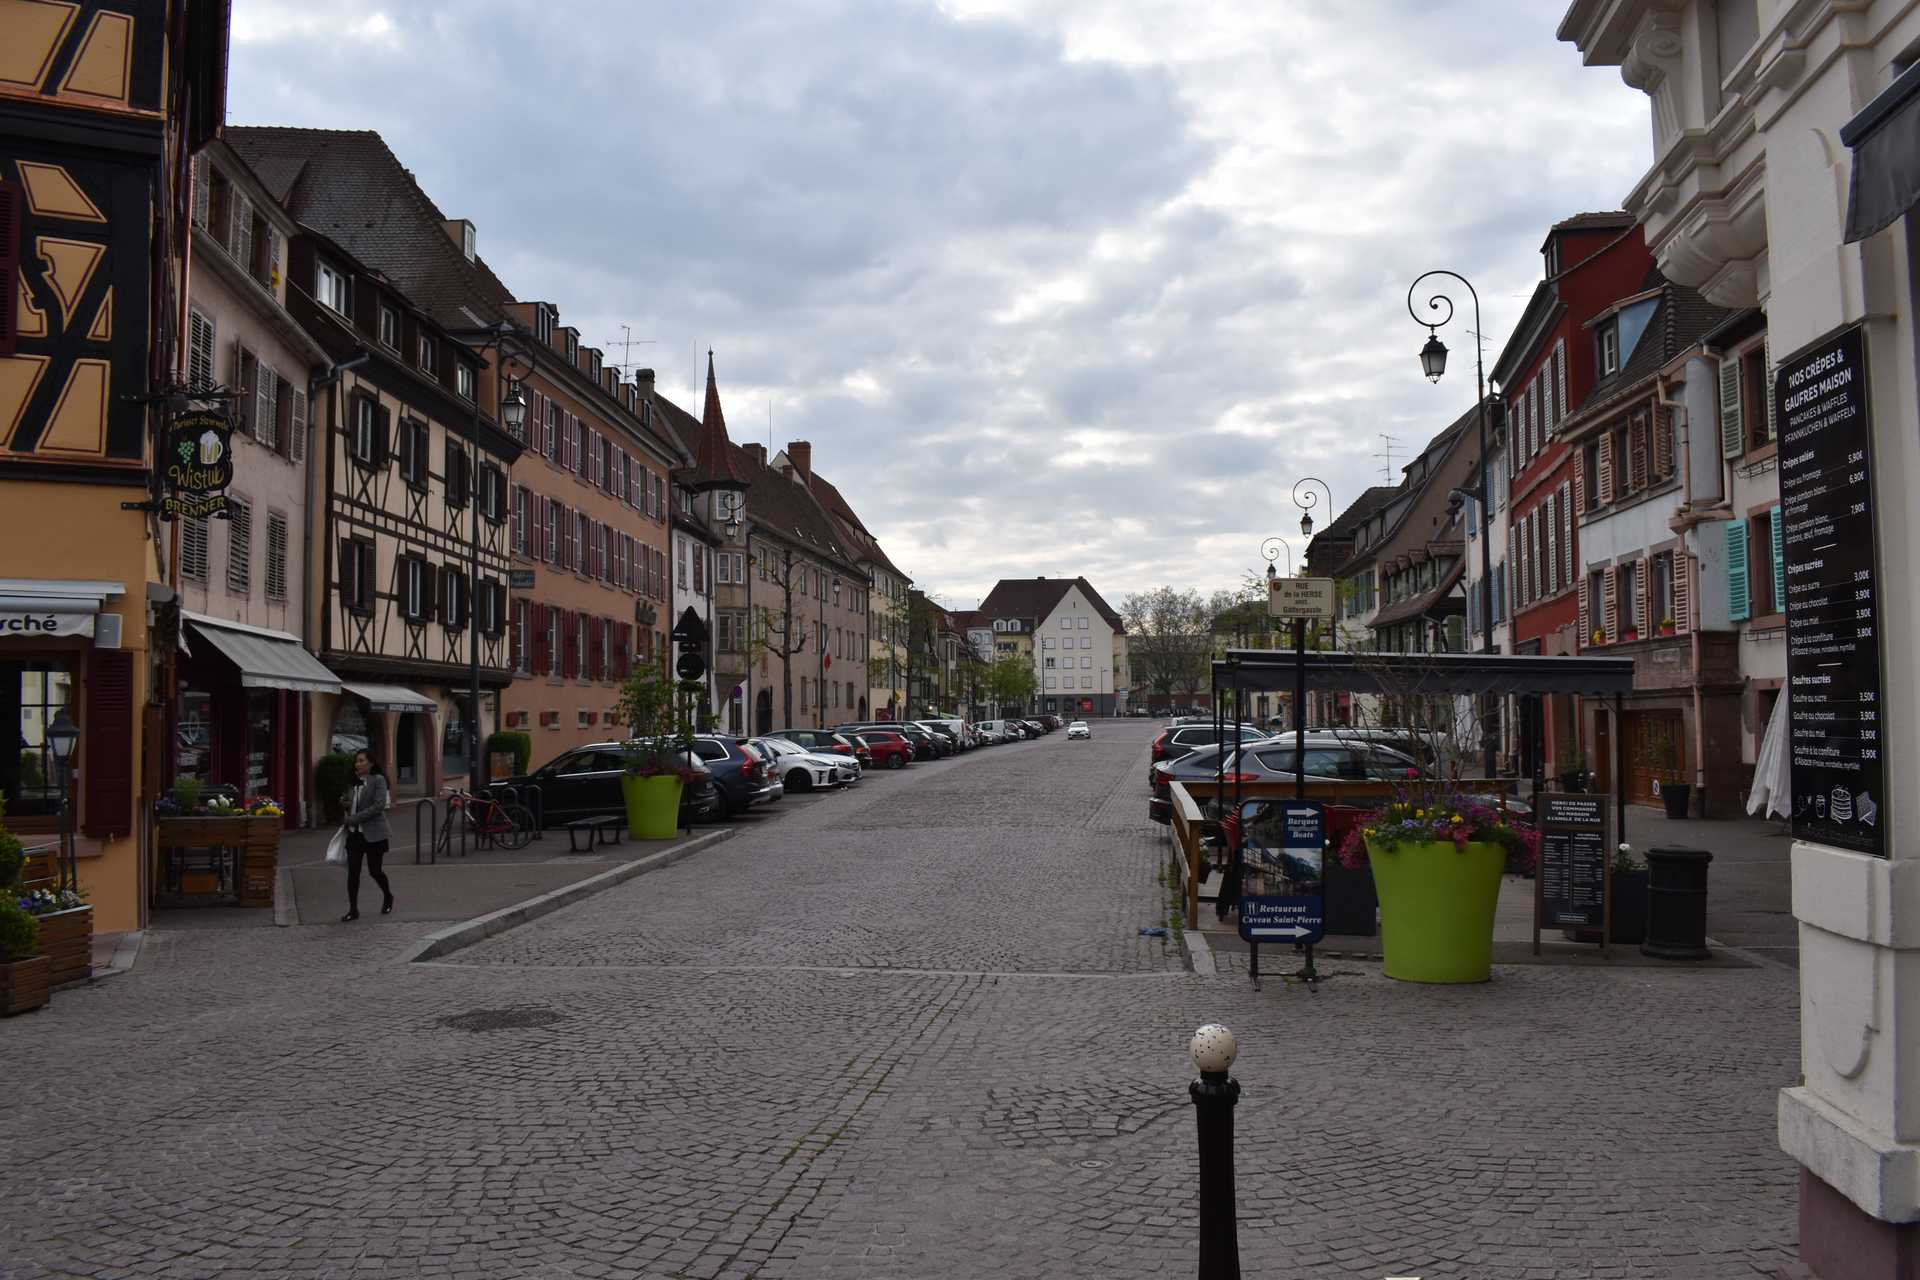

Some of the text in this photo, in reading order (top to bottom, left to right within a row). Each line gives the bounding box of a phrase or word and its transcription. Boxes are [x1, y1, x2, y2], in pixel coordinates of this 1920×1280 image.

[1789, 348, 1844, 388] NOS CRÊPES &
[1785, 368, 1852, 412] GAUFRES MAISON
[1790, 407, 1816, 428] PANCAKES
[1822, 392, 1848, 413] WAFFLES
[1785, 420, 1823, 445] PFANNKUCHEN
[1829, 405, 1856, 424] WAFFELN
[1783, 450, 1815, 470] Crêpes salées
[168, 463, 224, 490] Wistub
[1803, 469, 1822, 481] fromage
[1849, 470, 1865, 485] 6,90€
[165, 497, 226, 517] BRENNER
[1851, 502, 1865, 517] 7,90€
[1788, 558, 1824, 576] Crêpes sucrées
[1295, 582, 1310, 590] RUE
[1792, 673, 1831, 686] Gaufres sucrées
[1814, 694, 1827, 703] sucre
[1815, 710, 1835, 721] chocolat
[1287, 817, 1319, 827] Barques
[1292, 831, 1314, 839] Boats
[1259, 904, 1307, 914] Restaurant
[1242, 914, 1322, 925] Caveau Saint-Pierre
